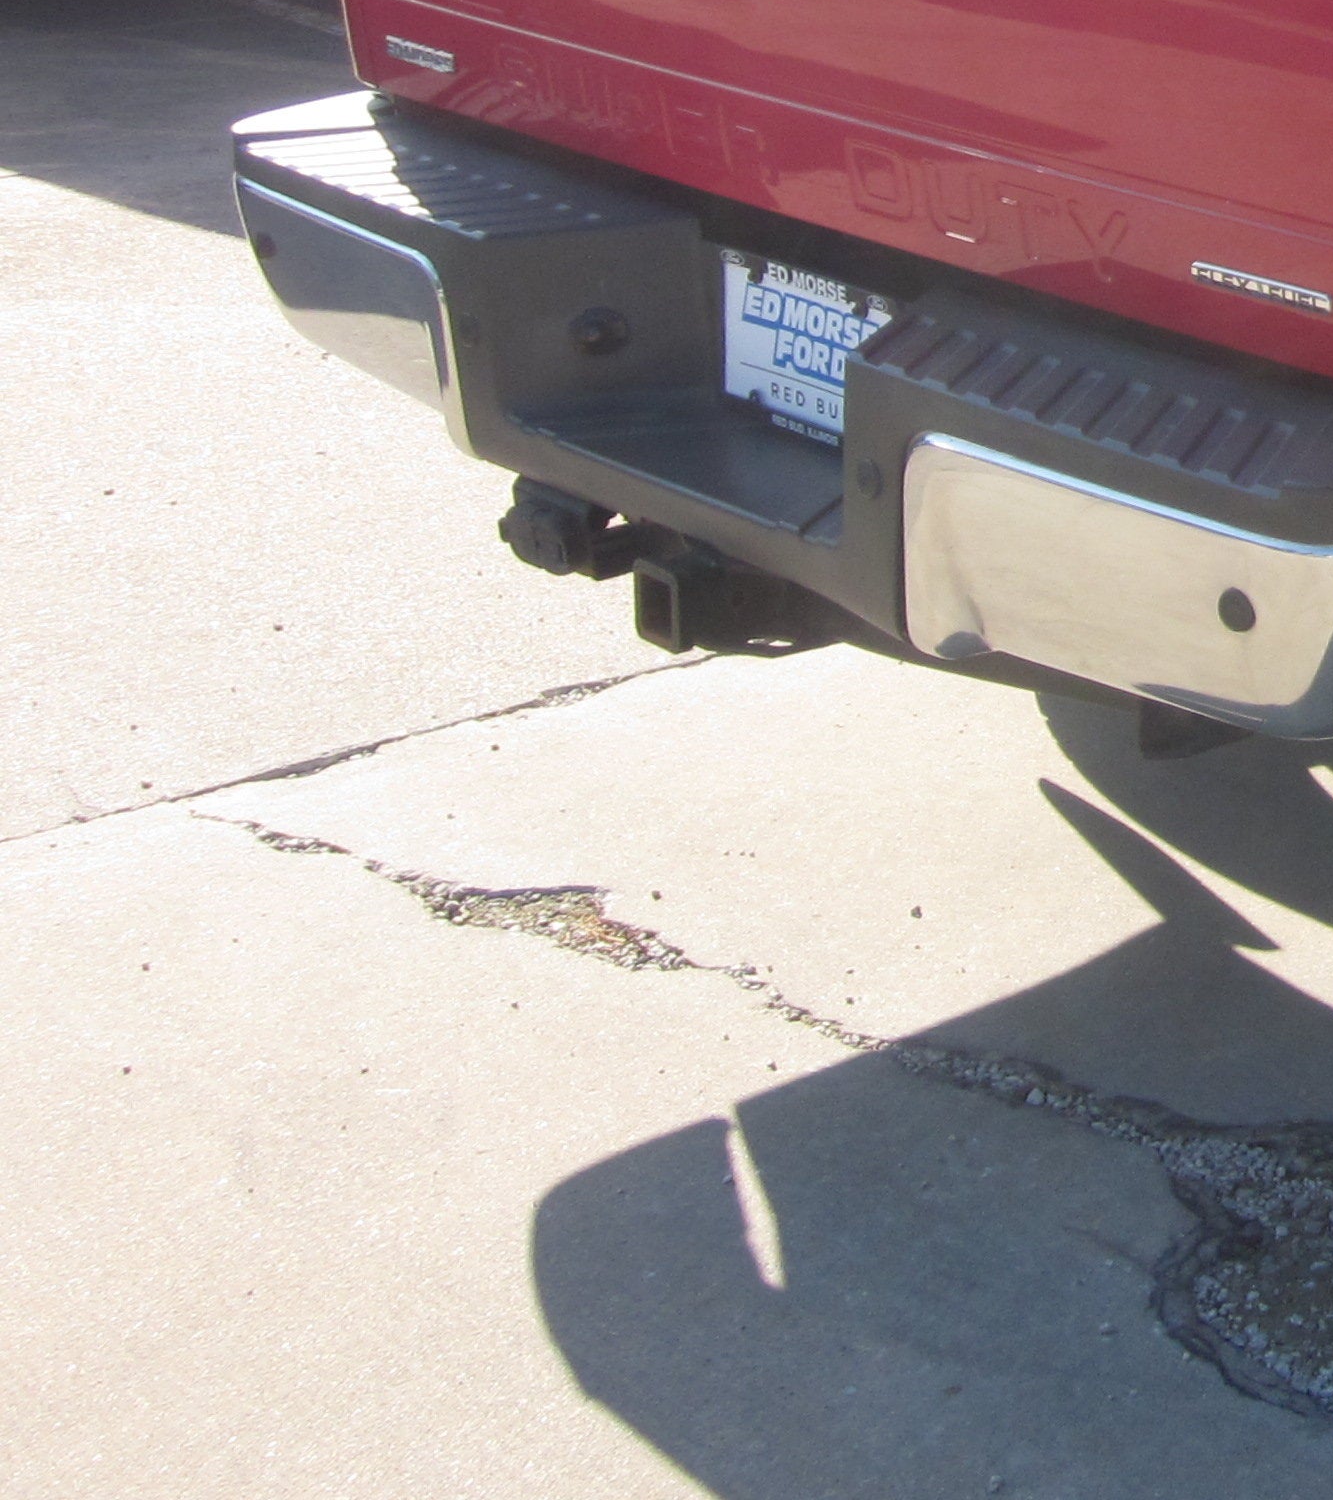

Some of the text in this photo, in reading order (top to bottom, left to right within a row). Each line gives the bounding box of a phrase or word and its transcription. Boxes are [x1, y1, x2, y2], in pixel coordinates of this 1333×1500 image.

[844, 137, 1130, 284] DUTY
[743, 286, 780, 322] ED
[767, 262, 789, 284] ED
[790, 271, 847, 304] MORSE
[774, 329, 846, 382] FORD
[770, 382, 839, 419] RED BU
